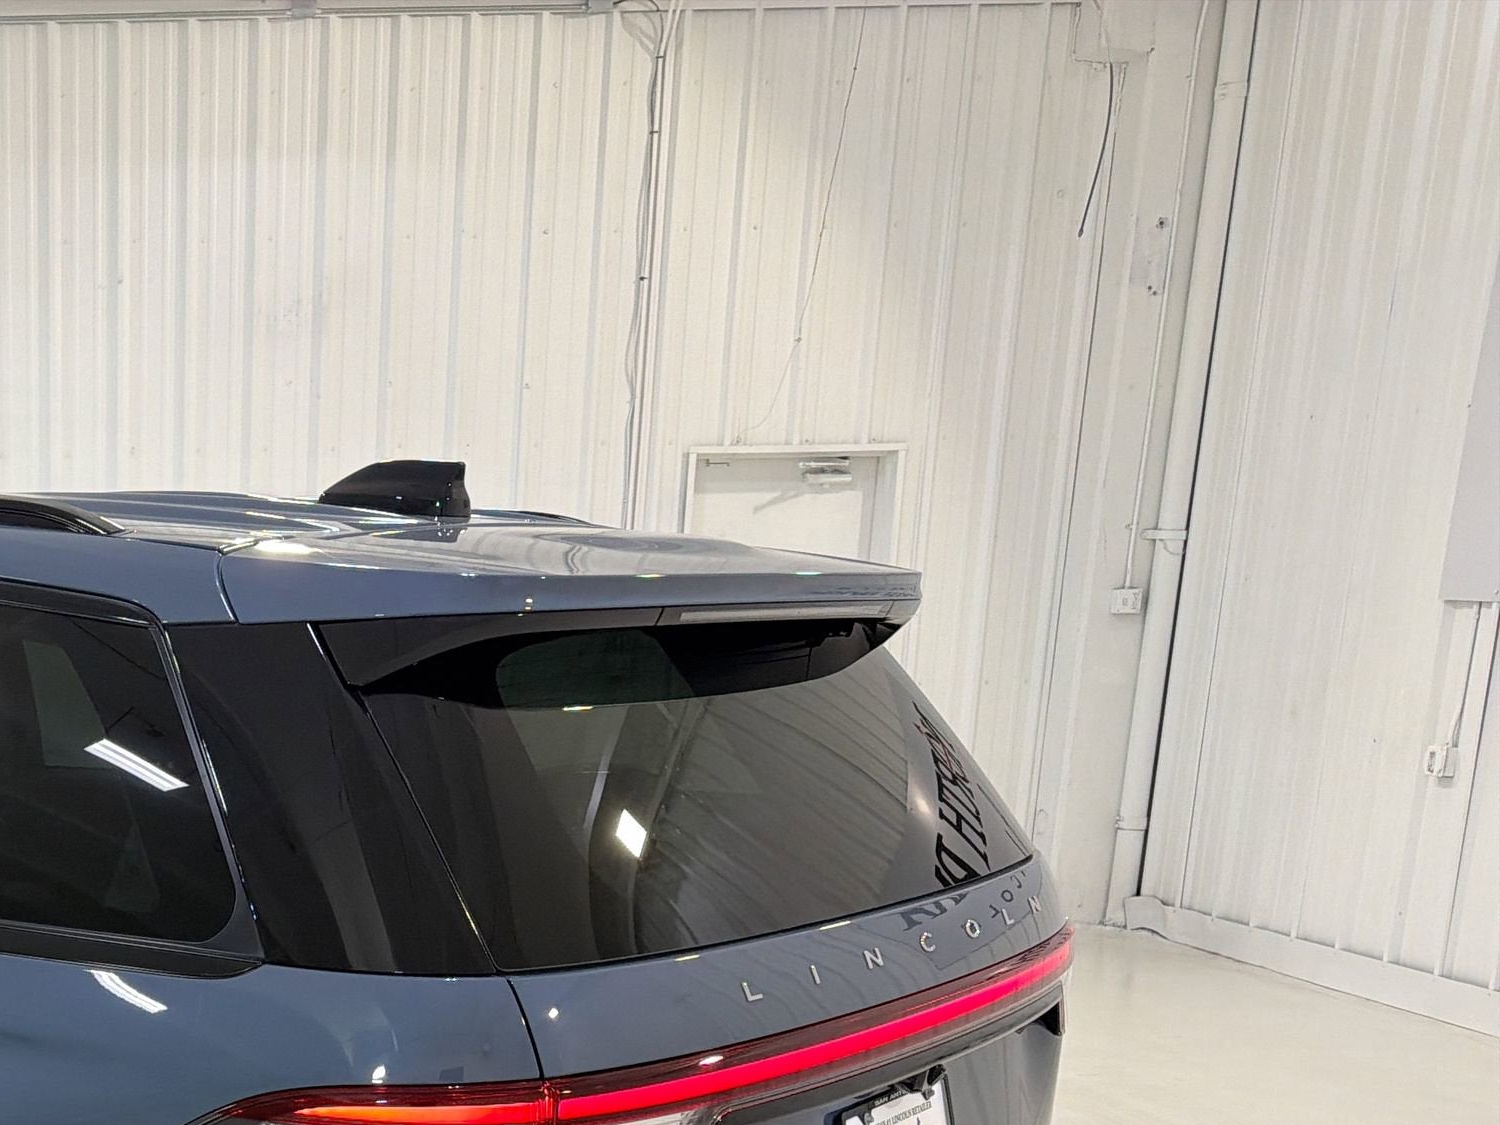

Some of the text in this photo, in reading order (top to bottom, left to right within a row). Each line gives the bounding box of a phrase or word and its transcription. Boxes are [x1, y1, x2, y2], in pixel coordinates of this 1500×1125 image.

[741, 896, 1041, 1002] LINCOLN
[891, 1109, 912, 1124] LINCOLN
[911, 1101, 933, 1116] RETAILER
